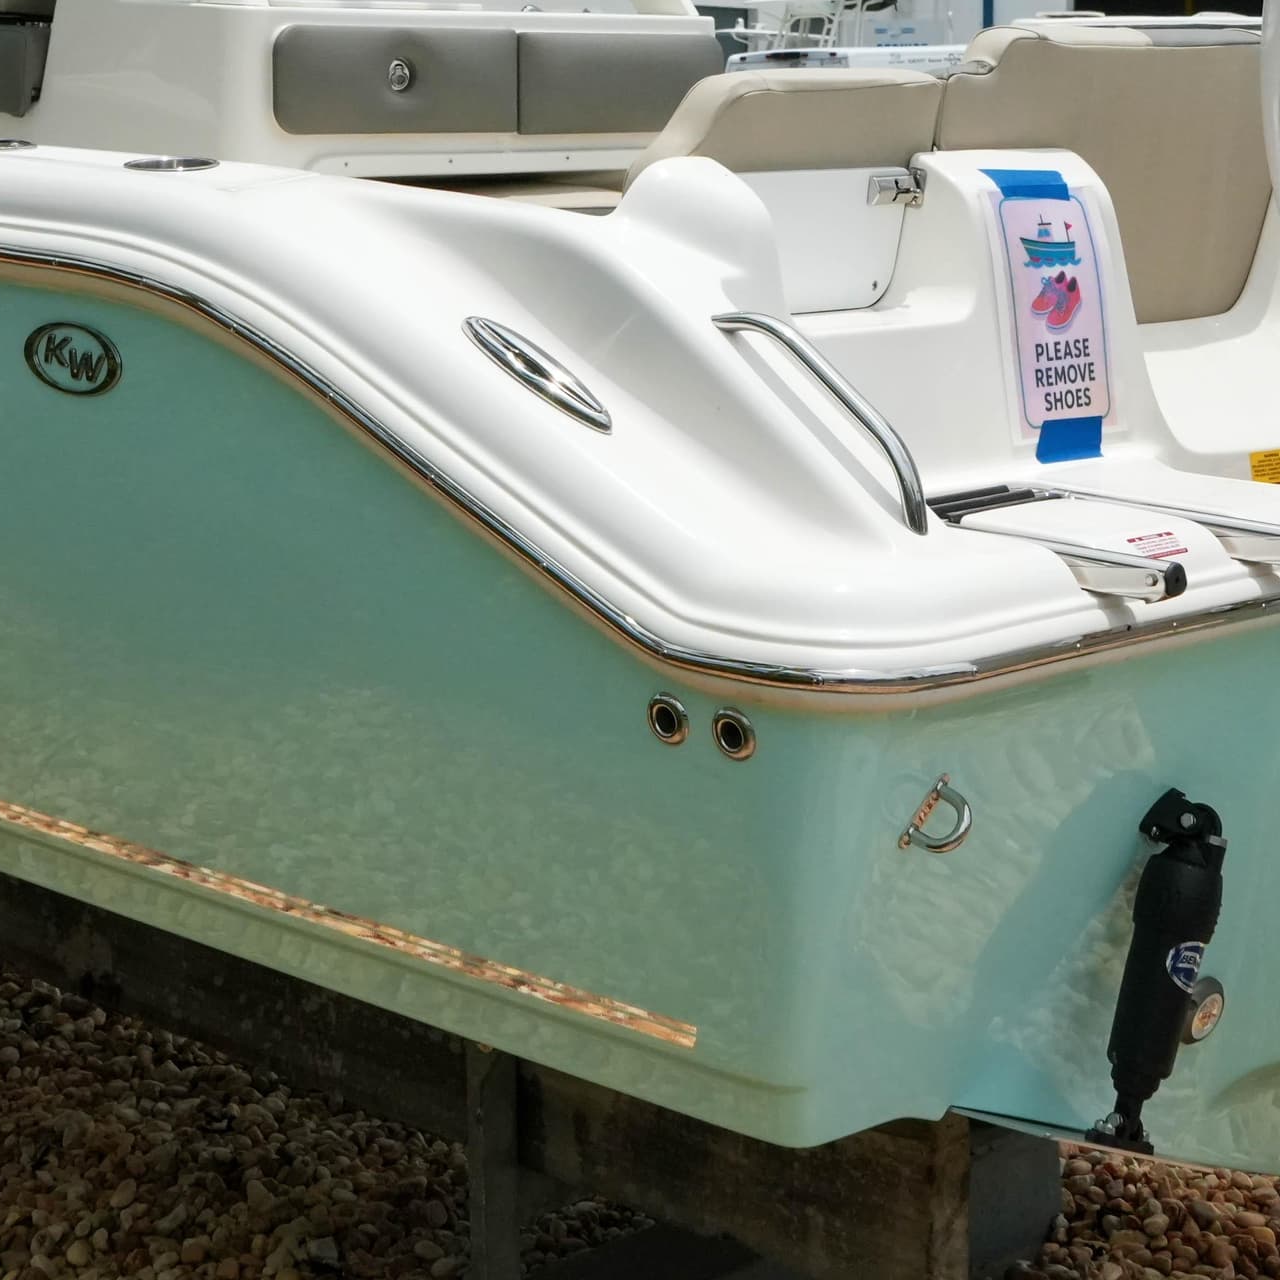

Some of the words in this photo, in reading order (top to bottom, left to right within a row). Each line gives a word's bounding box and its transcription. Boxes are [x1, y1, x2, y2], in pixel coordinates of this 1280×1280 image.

[43, 332, 107, 384] KW
[1034, 338, 1091, 363] PLEASE
[1034, 362, 1097, 388] REMOVE
[1043, 387, 1092, 412] SHOES
